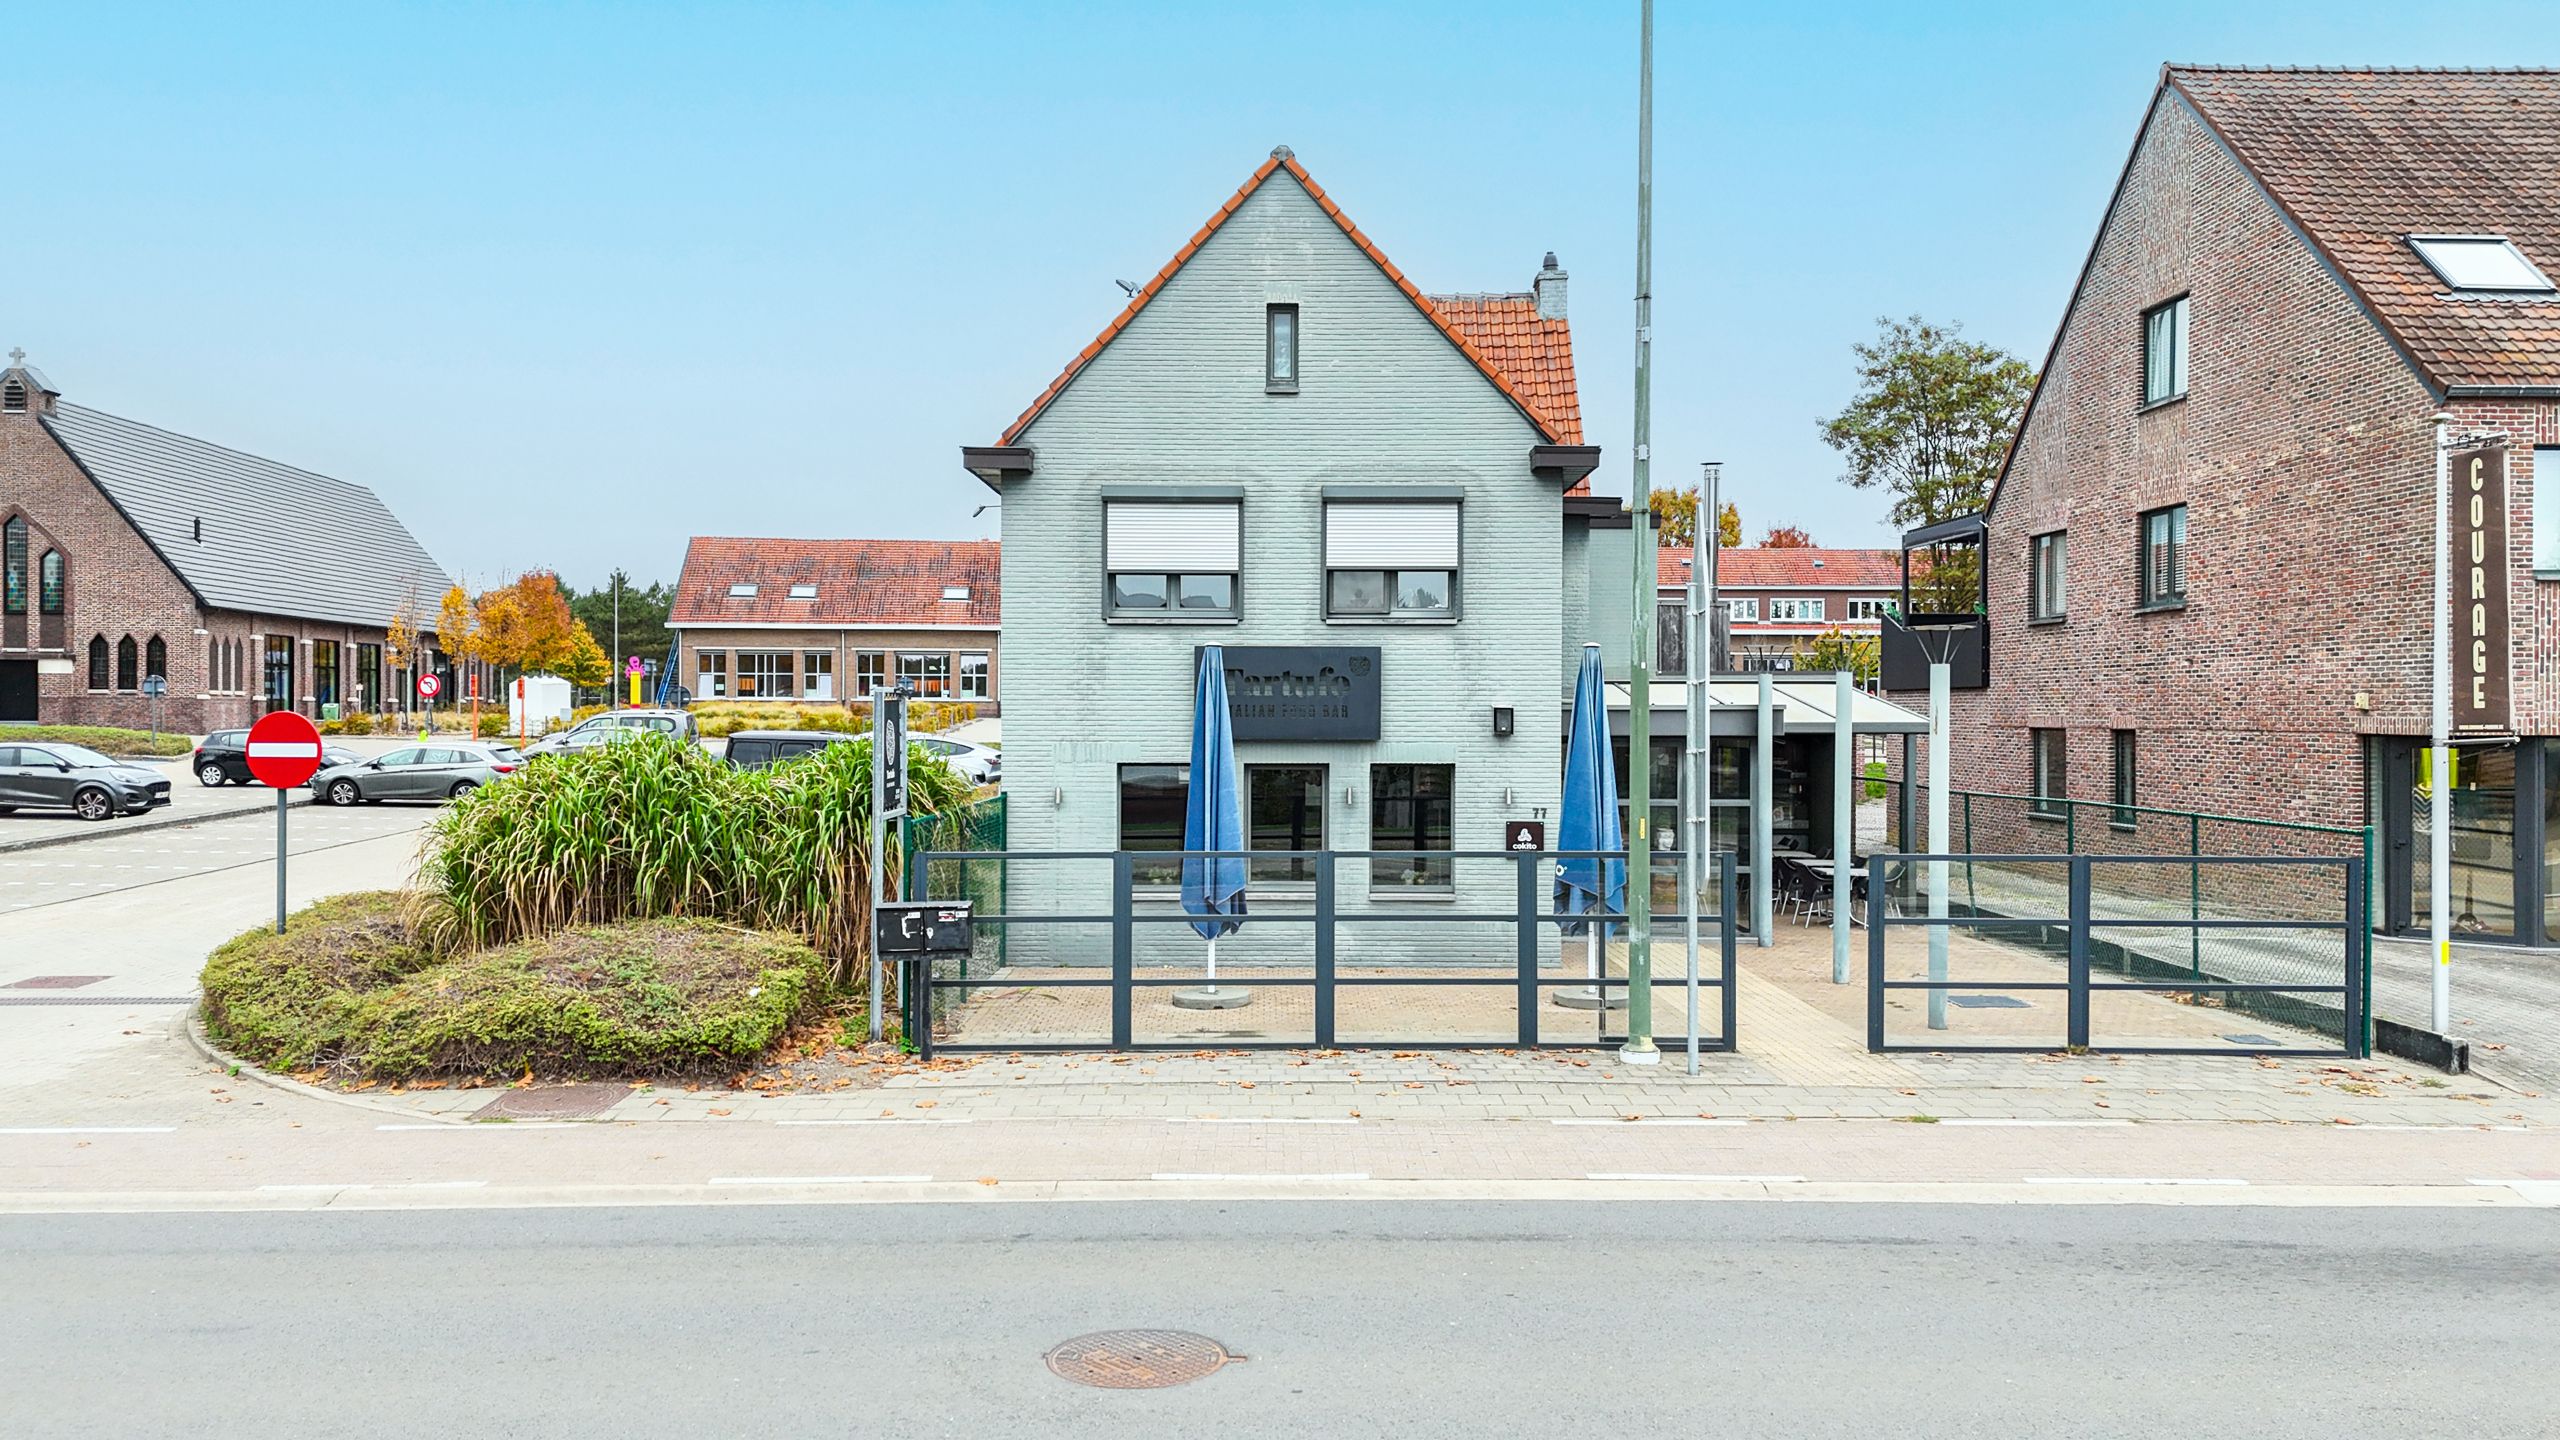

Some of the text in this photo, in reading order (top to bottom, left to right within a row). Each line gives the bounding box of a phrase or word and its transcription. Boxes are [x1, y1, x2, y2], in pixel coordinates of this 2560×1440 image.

[2470, 457, 2486, 709] COURAGE
[1224, 666, 1350, 698] Tartufo
[1229, 704, 1349, 718] TALIAN FOOD BAR
[1532, 807, 1548, 819] 77
[1512, 842, 1537, 850] cokito
